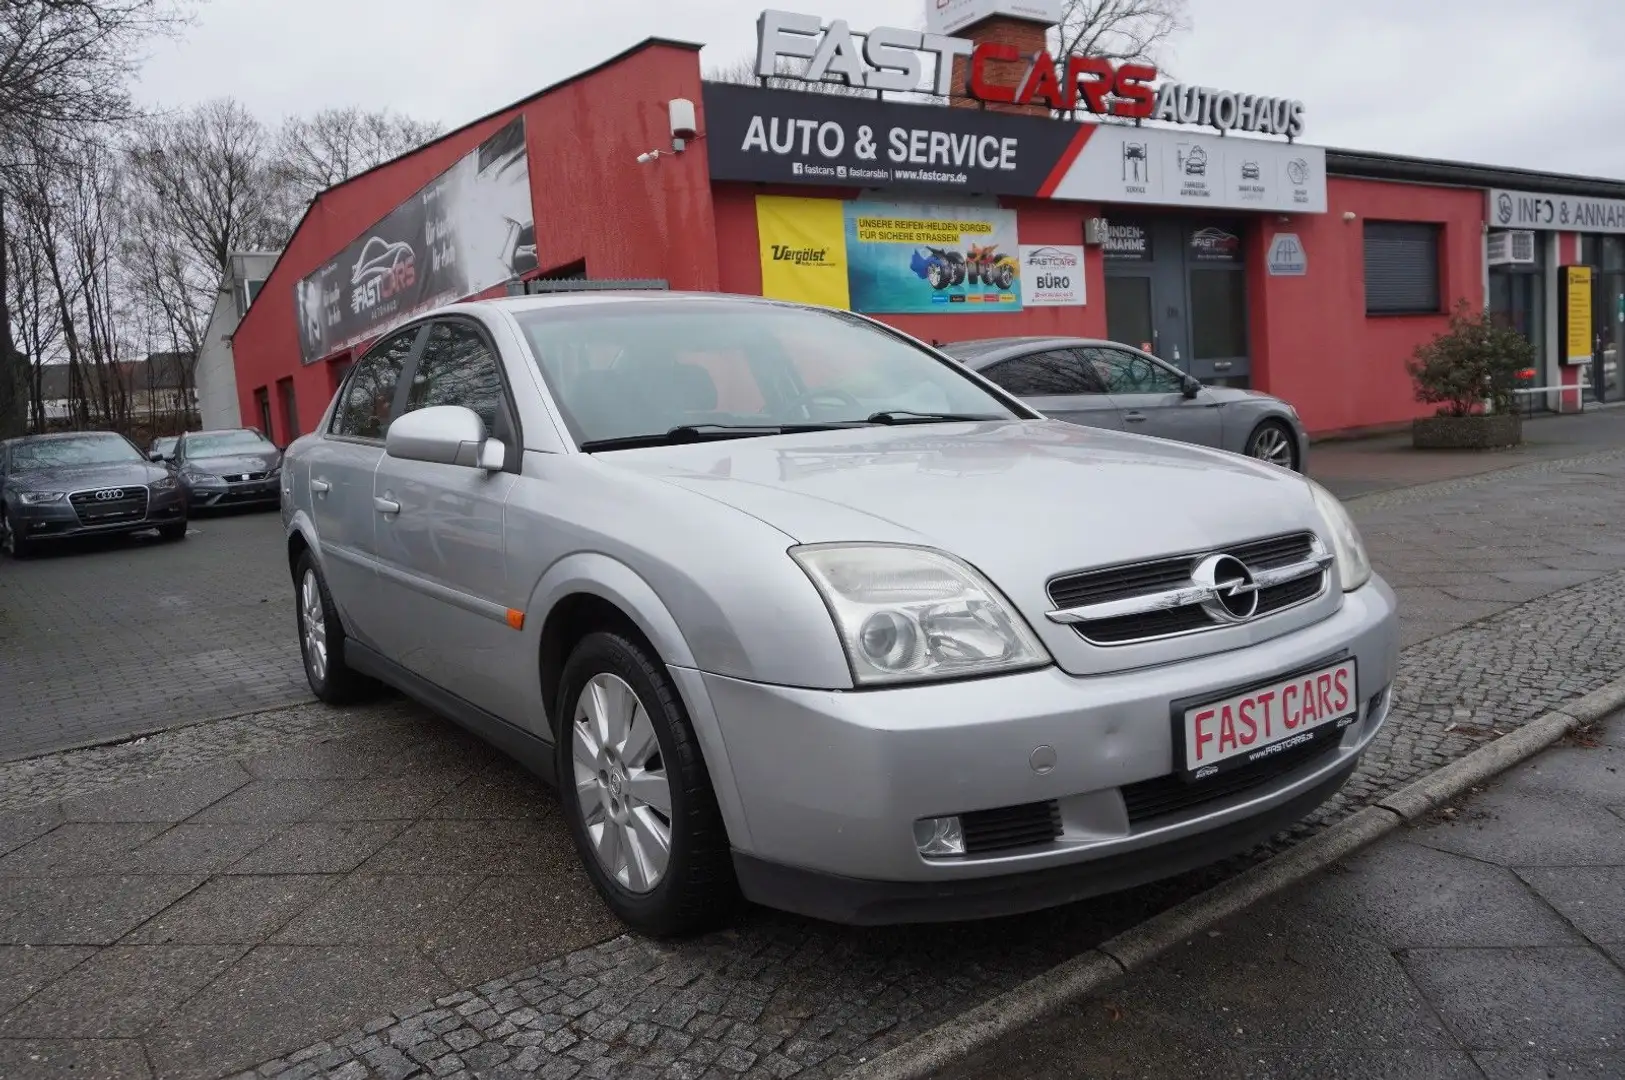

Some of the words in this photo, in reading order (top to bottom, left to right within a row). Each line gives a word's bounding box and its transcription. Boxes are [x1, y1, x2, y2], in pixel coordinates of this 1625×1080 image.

[1155, 82, 1305, 138] AUTOHAUS
[741, 115, 845, 158] AUTO
[854, 125, 877, 161] &
[888, 126, 1018, 170] SERVICE
[804, 165, 835, 176] fastcars
[895, 169, 967, 183] www.fastcars.de
[1560, 201, 1571, 224] &
[859, 219, 892, 229] UNSERE
[895, 220, 958, 232] REIFEN-HELDEN
[960, 223, 991, 233] SORGEN
[1108, 225, 1144, 238] UNDEN-
[860, 229, 876, 240] FÜR
[878, 231, 914, 241] SICHERE
[916, 232, 959, 243] STRASSEN!
[1102, 238, 1146, 250] NNAHME
[771, 245, 826, 264] Vergölst
[1036, 272, 1070, 289] BÜRO
[1194, 691, 1275, 761] FAST
[1282, 668, 1349, 730] CARS
